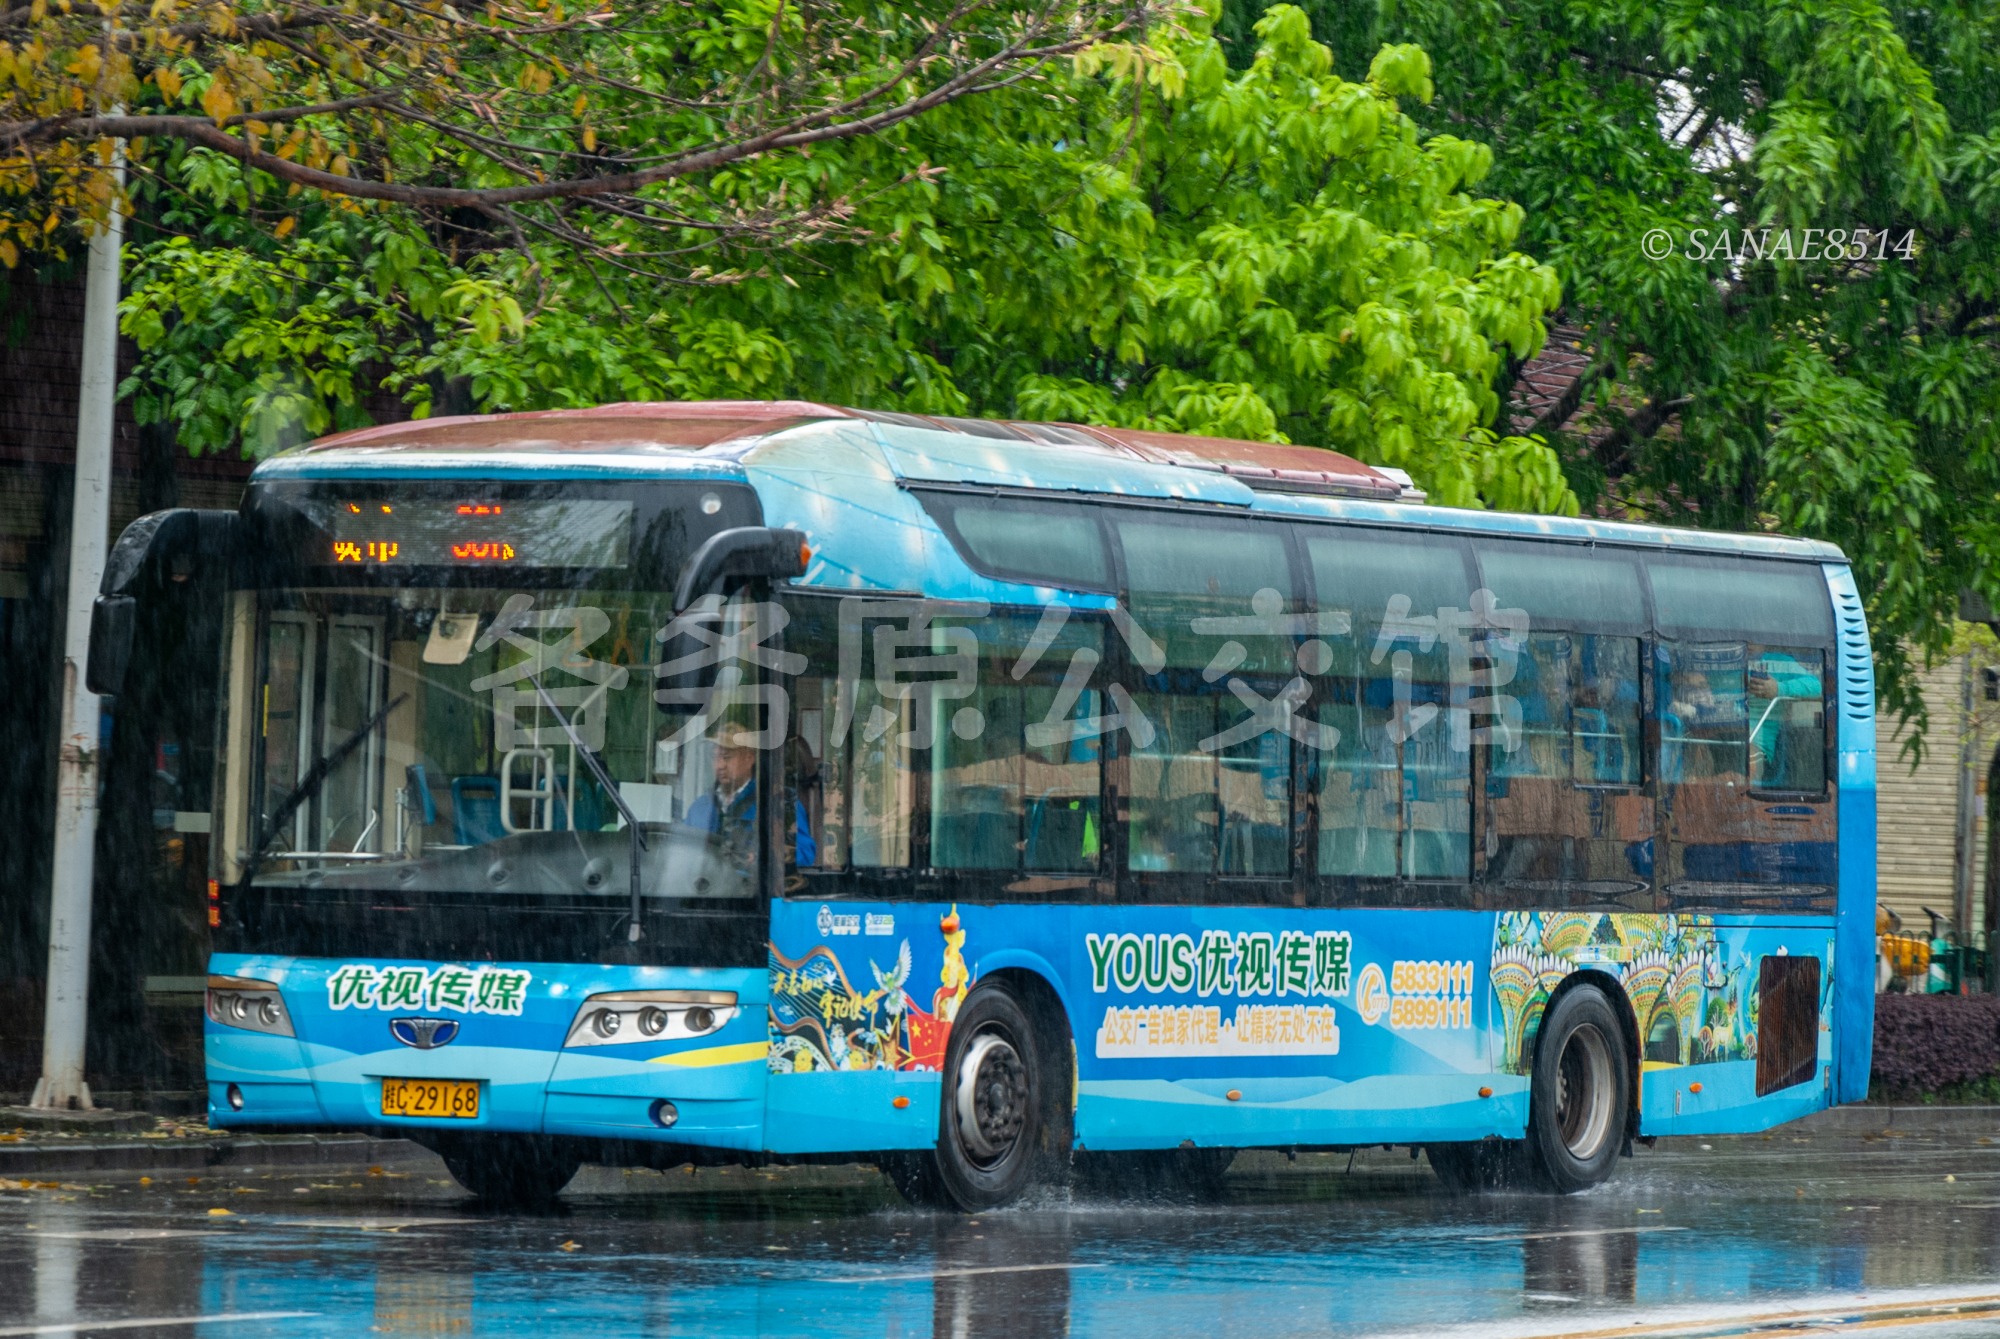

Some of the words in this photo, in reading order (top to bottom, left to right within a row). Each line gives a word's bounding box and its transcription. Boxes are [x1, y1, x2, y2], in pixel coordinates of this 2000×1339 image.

[330, 966, 528, 1012] 优视传媒
[1392, 964, 1472, 992] 5833111
[1391, 999, 1472, 1026] 5899111
